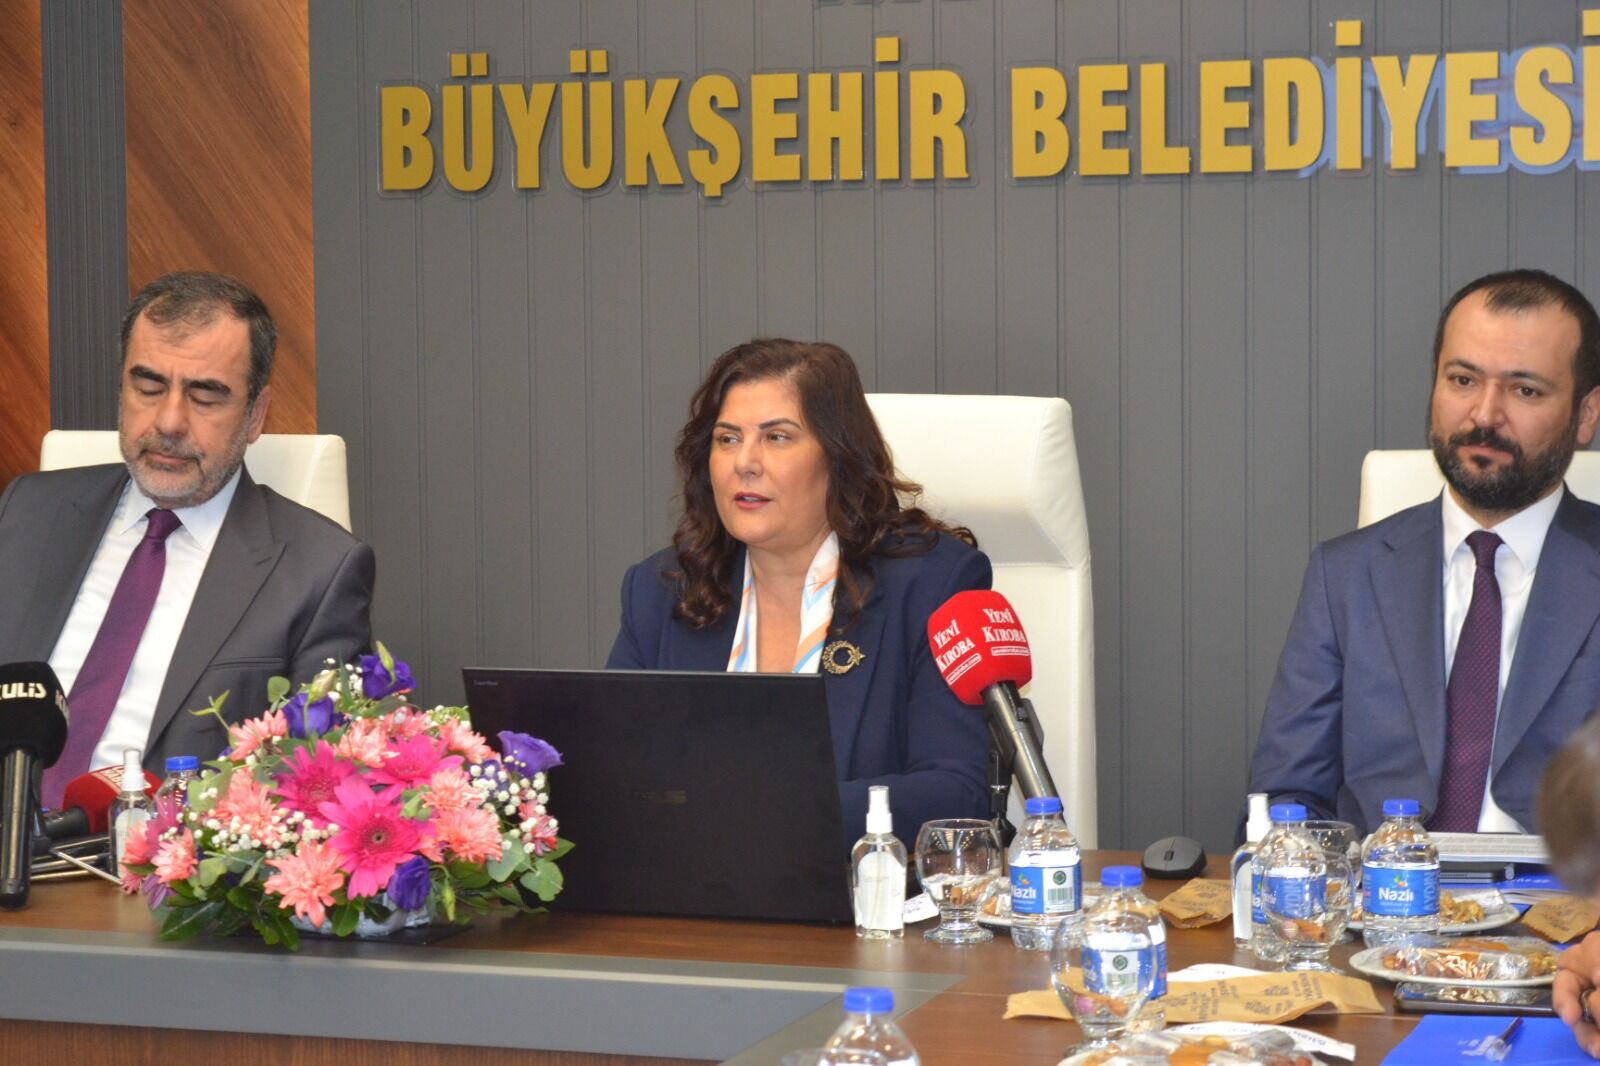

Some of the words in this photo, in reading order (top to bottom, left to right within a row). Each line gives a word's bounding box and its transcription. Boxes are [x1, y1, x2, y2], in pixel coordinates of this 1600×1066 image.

[381, 37, 969, 196] BÜYÜKŞEHİR
[1012, 9, 1600, 177] BELEDİYESİ
[981, 626, 1027, 643] KIROBA
[936, 637, 976, 673] KIROBA
